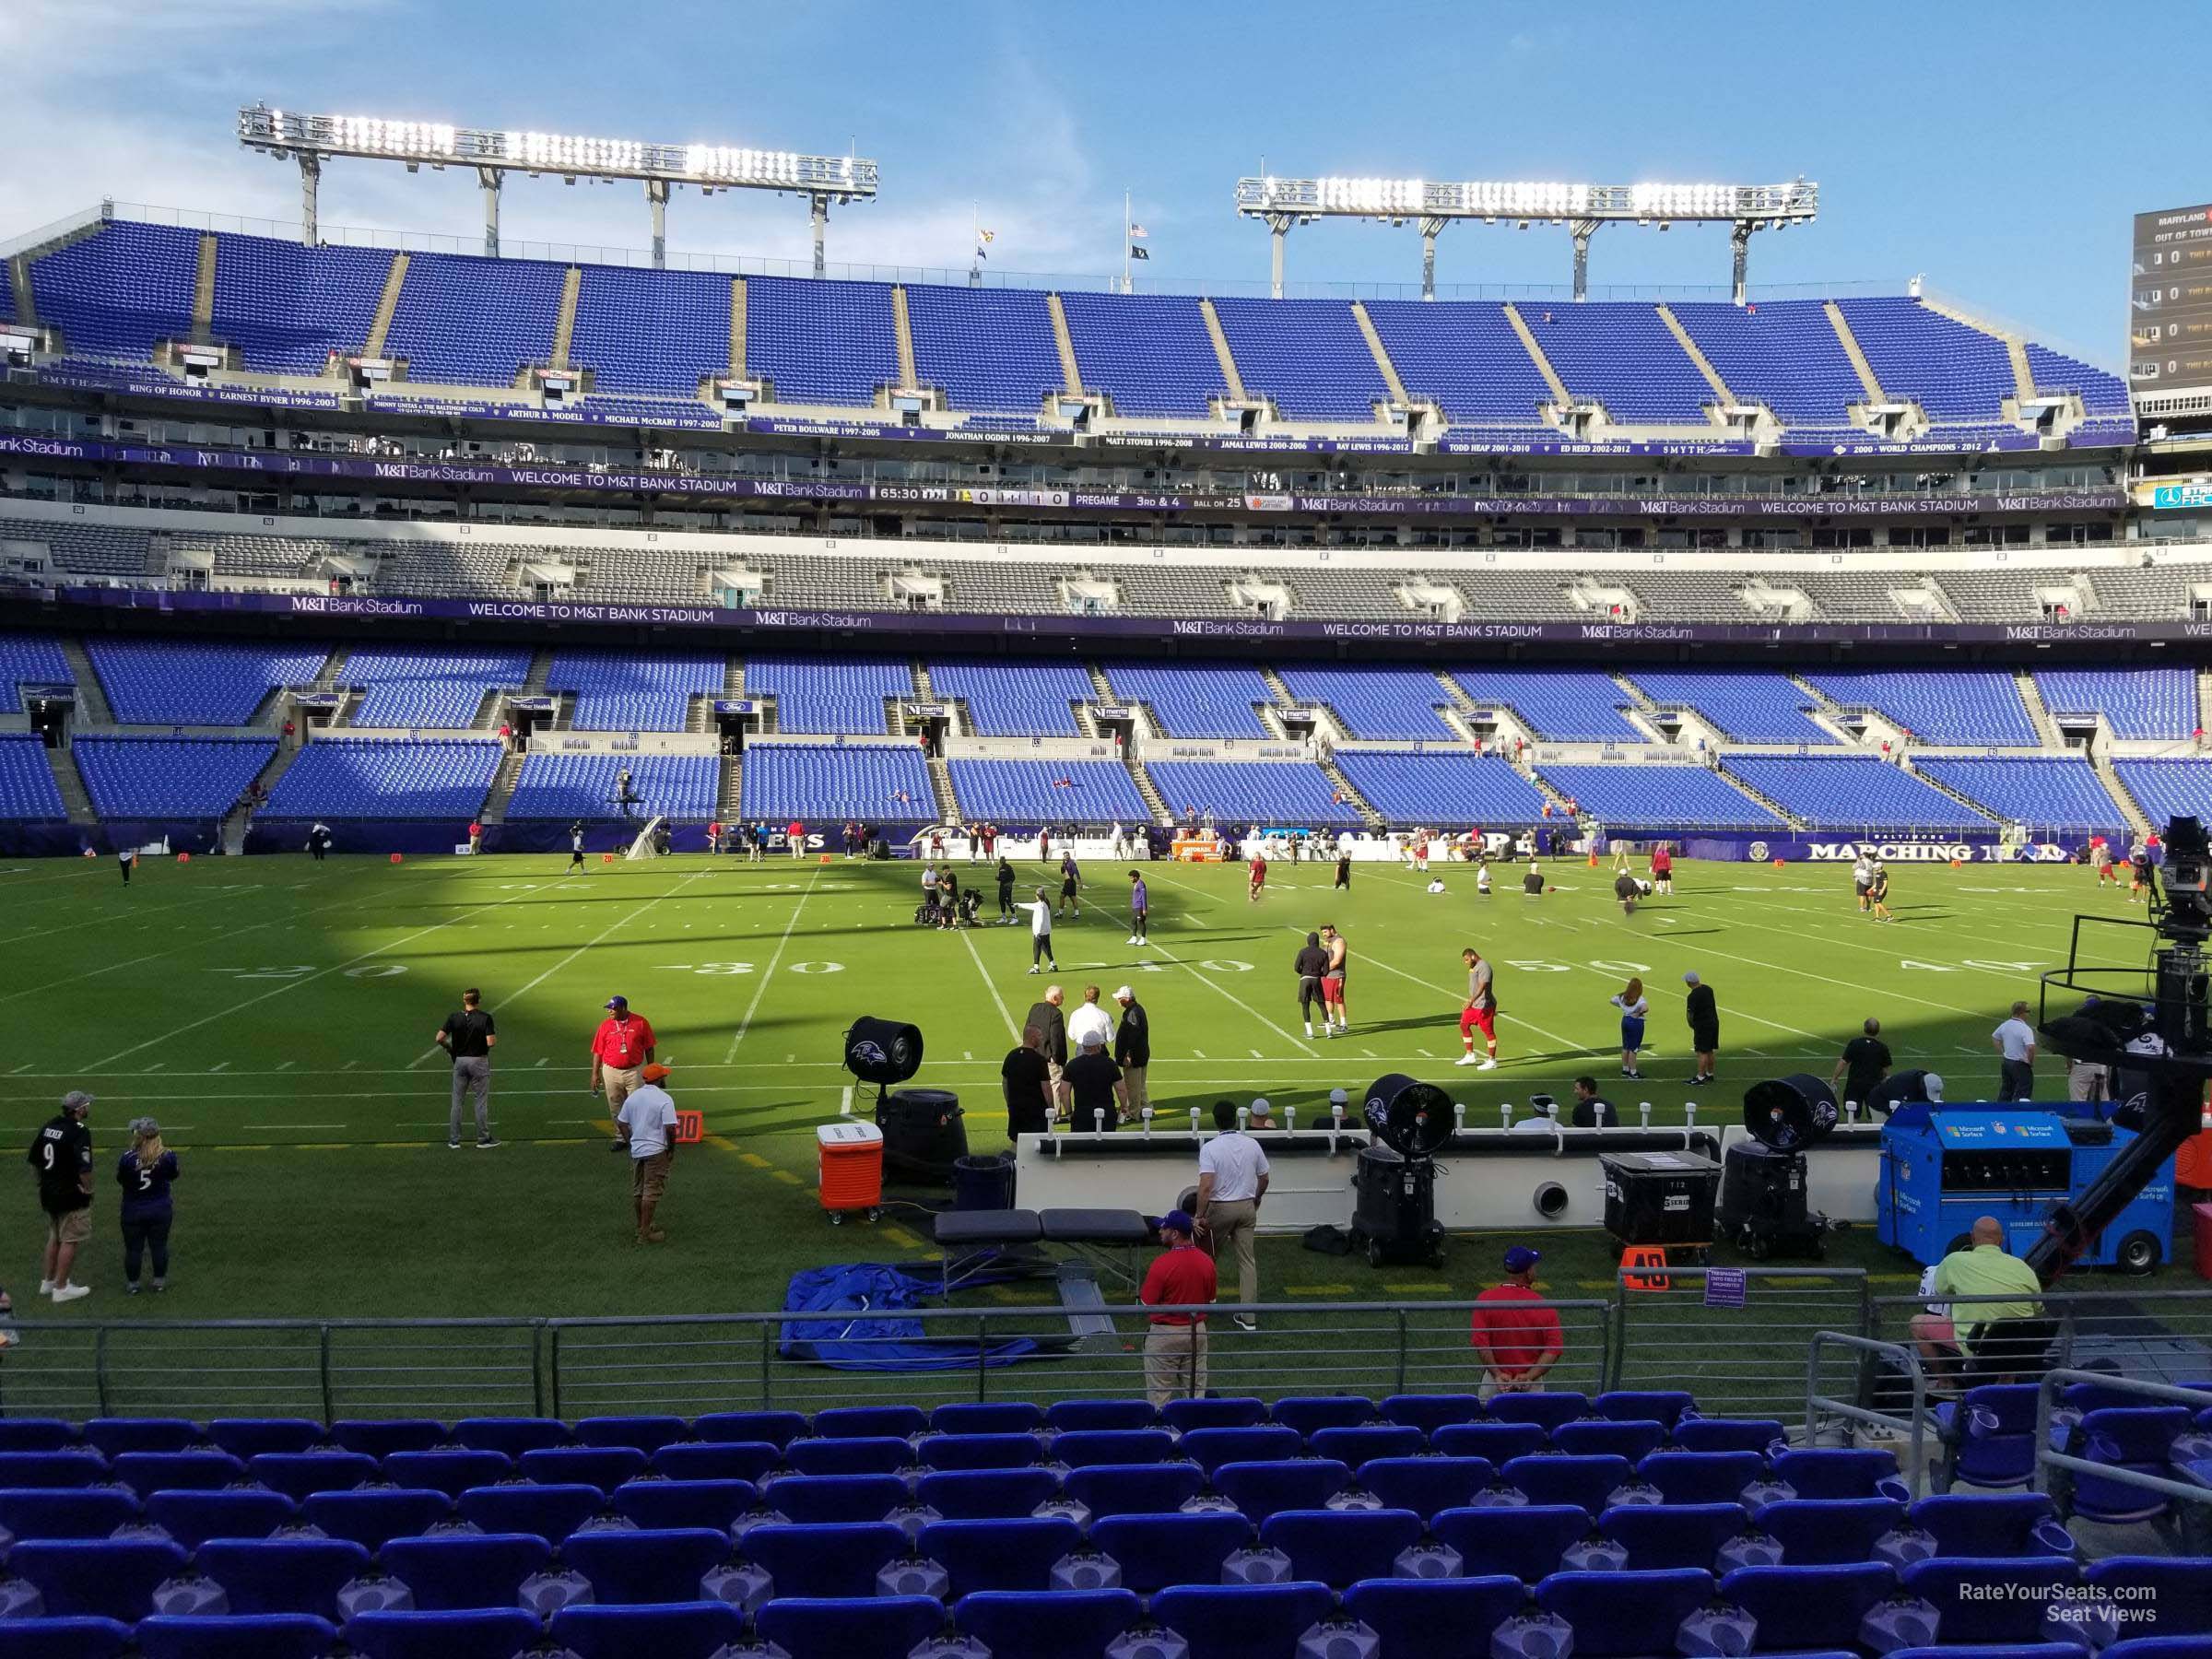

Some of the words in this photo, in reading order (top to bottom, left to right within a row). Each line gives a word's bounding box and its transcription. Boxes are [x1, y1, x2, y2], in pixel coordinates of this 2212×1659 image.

[2159, 213, 2206, 226] MARYLAND
[2155, 233, 2173, 242] OUT
[2175, 231, 2188, 241] OF
[2171, 251, 2180, 264] 0
[2170, 288, 2179, 300] 0
[2169, 324, 2178, 336] 0
[2168, 360, 2176, 373] 0
[130, 384, 152, 393] RING
[155, 386, 167, 394] OF
[170, 385, 201, 397] HONOR
[220, 393, 257, 402] EARNEST
[261, 395, 288, 405] BYNER
[290, 394, 335, 406] 1996-2003
[552, 412, 583, 420] MODELL
[606, 415, 639, 424] MICHAEL
[641, 418, 677, 426] McCRARY
[680, 419, 721, 428] 1997-2002
[799, 426, 838, 434] BOULWARE
[841, 428, 879, 436] 1997-2005
[946, 431, 982, 440] JONATHAN
[23, 439, 83, 458] Stadium
[1105, 438, 1124, 446] MATT
[1125, 439, 1154, 447] STOVER
[1155, 439, 1193, 447] 1996-2008
[1221, 441, 1244, 449] JAMAL
[375, 463, 408, 478] M&T
[410, 465, 440, 479] Bank
[442, 466, 493, 482] Stadium
[512, 471, 581, 484] WELCOME
[585, 475, 604, 486] TO
[608, 477, 636, 488] M&T
[641, 477, 676, 489] BANK
[680, 479, 735, 492] STADIUM
[755, 482, 784, 495] M&T
[786, 484, 814, 496] Bank
[816, 484, 862, 499] Stadium
[881, 488, 918, 500] 65:30
[1077, 494, 1119, 506] PREGAME
[1137, 497, 1156, 506] 3RD
[1159, 497, 1167, 507] &
[1172, 498, 1179, 506] 4
[1228, 499, 1240, 507] 25
[1301, 498, 1330, 511] M&T
[1331, 499, 1357, 511] Bank
[1359, 499, 1404, 512] Stadium
[1996, 498, 2029, 512] M&T
[2030, 496, 2062, 510] Bank
[2063, 493, 2116, 508] Stadium
[1640, 501, 1669, 513] M&T
[1670, 501, 1698, 513] Bank
[1699, 501, 1745, 513] Stadium
[1761, 501, 1824, 514] WELCOME
[1828, 502, 1845, 512] TO
[1850, 501, 1877, 512] M&T
[1881, 501, 1915, 512] BANK
[1921, 500, 1978, 511] STADIUM
[292, 596, 328, 611] M&T
[330, 598, 364, 613] Bank
[366, 600, 421, 615] Stadium
[469, 604, 545, 617] WELCOME
[549, 606, 570, 618] TO
[575, 606, 605, 618] M&T
[610, 608, 648, 620] BANK
[653, 609, 713, 622] STADIUM
[756, 608, 788, 626] M&T
[790, 612, 819, 626] Bank
[822, 613, 871, 629] Stadium
[1173, 620, 1204, 634] M&T
[1206, 621, 1233, 634] Bank
[1236, 622, 1283, 636] Stadium
[1324, 625, 1389, 635] WELCOME
[1394, 625, 1411, 635] TO
[1416, 625, 1442, 636] M&T
[1447, 626, 1481, 636] BANK
[1486, 626, 1541, 637] STADIUM
[1582, 626, 1613, 638] M&T
[1614, 626, 1643, 638] Bank
[1645, 626, 1693, 639] Stadium
[2006, 626, 2041, 639] M&T
[2043, 626, 2077, 638] Bank
[2078, 625, 2135, 638] Stadium
[2184, 624, 2212, 636] WE
[1806, 843, 1975, 861] MARCHING
[44, 1128, 64, 1141] TUCKER
[43, 1143, 54, 1171] 9
[139, 1170, 152, 1191] 5
[1633, 1253, 1667, 1288] 40
